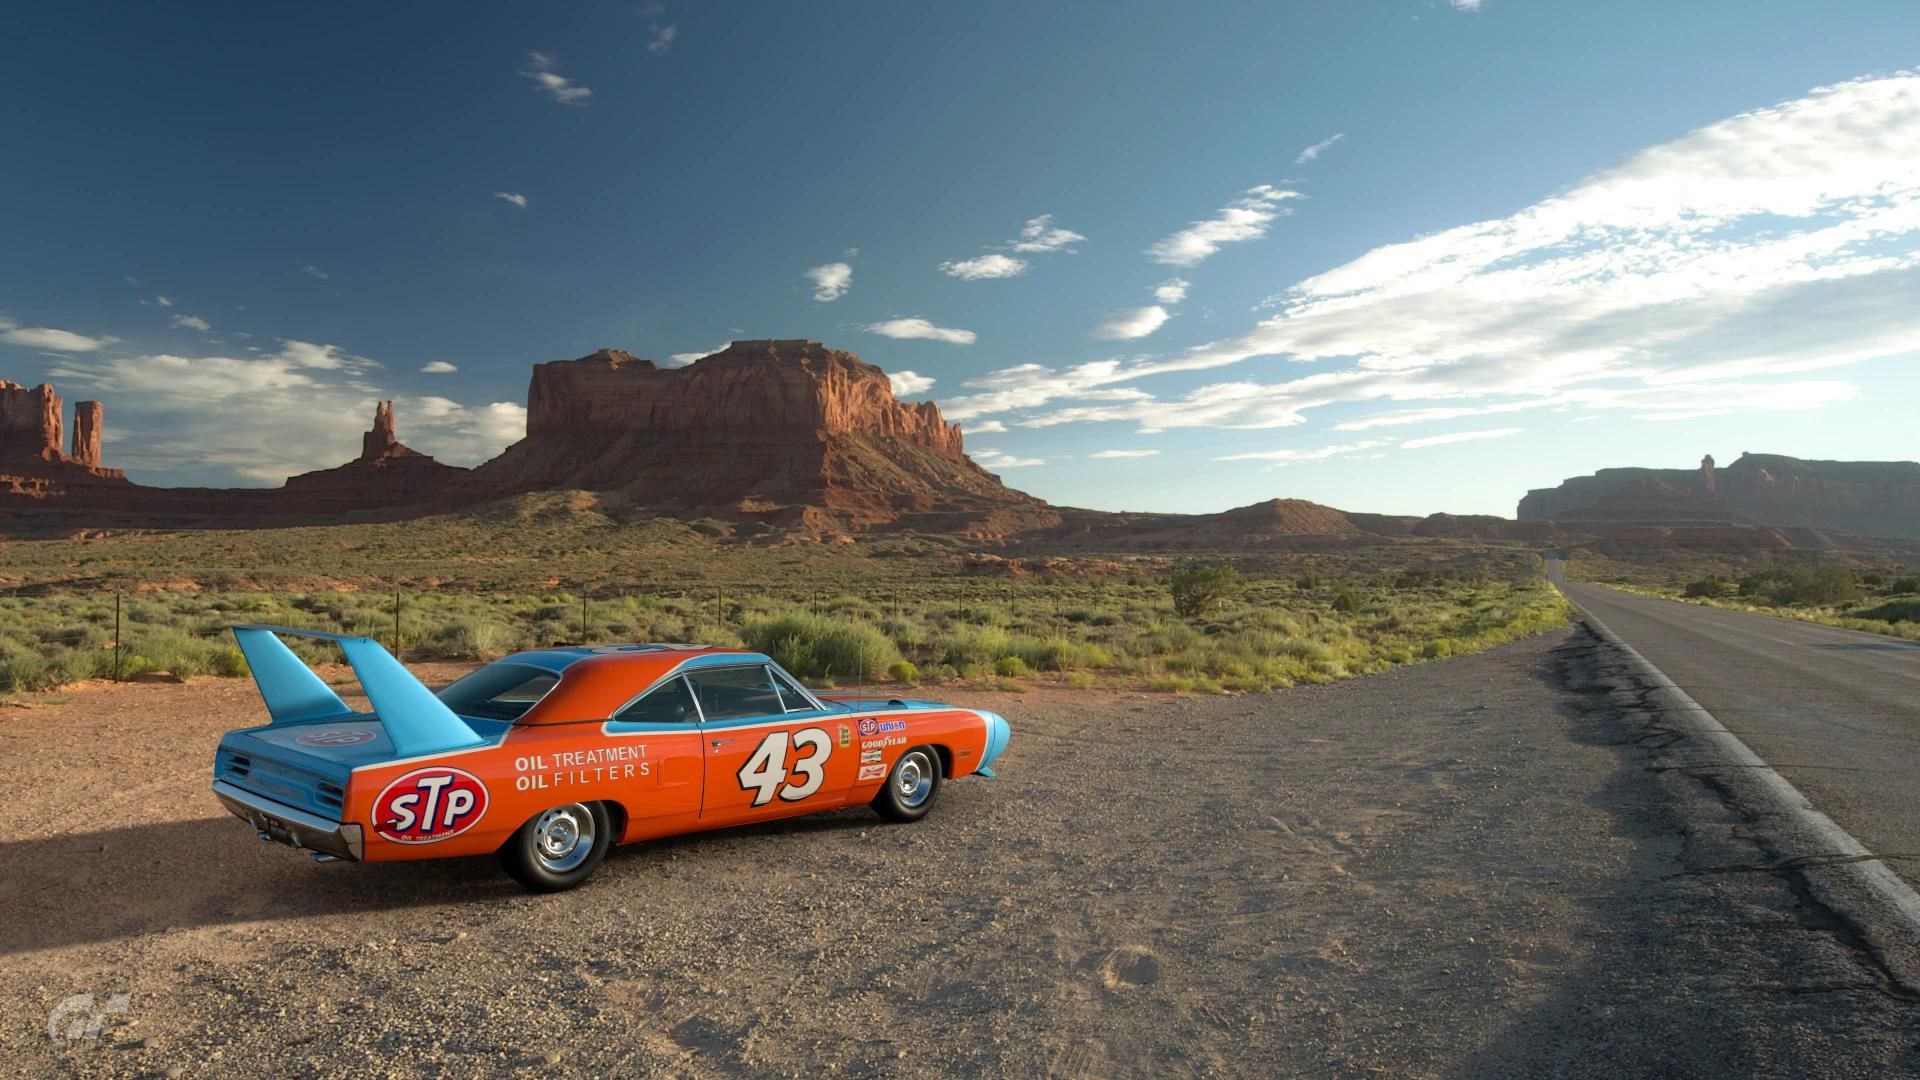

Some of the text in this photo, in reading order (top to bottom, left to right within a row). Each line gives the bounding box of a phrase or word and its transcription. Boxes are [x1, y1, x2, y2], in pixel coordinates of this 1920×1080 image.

[862, 720, 875, 732] STP
[861, 736, 907, 749] GOODYEAR
[515, 744, 647, 771] OIL TREATMENT
[737, 727, 833, 807] 43
[515, 762, 650, 791] OIL FILTERS
[386, 774, 475, 832] STP
[416, 829, 455, 842] TREATMENT
